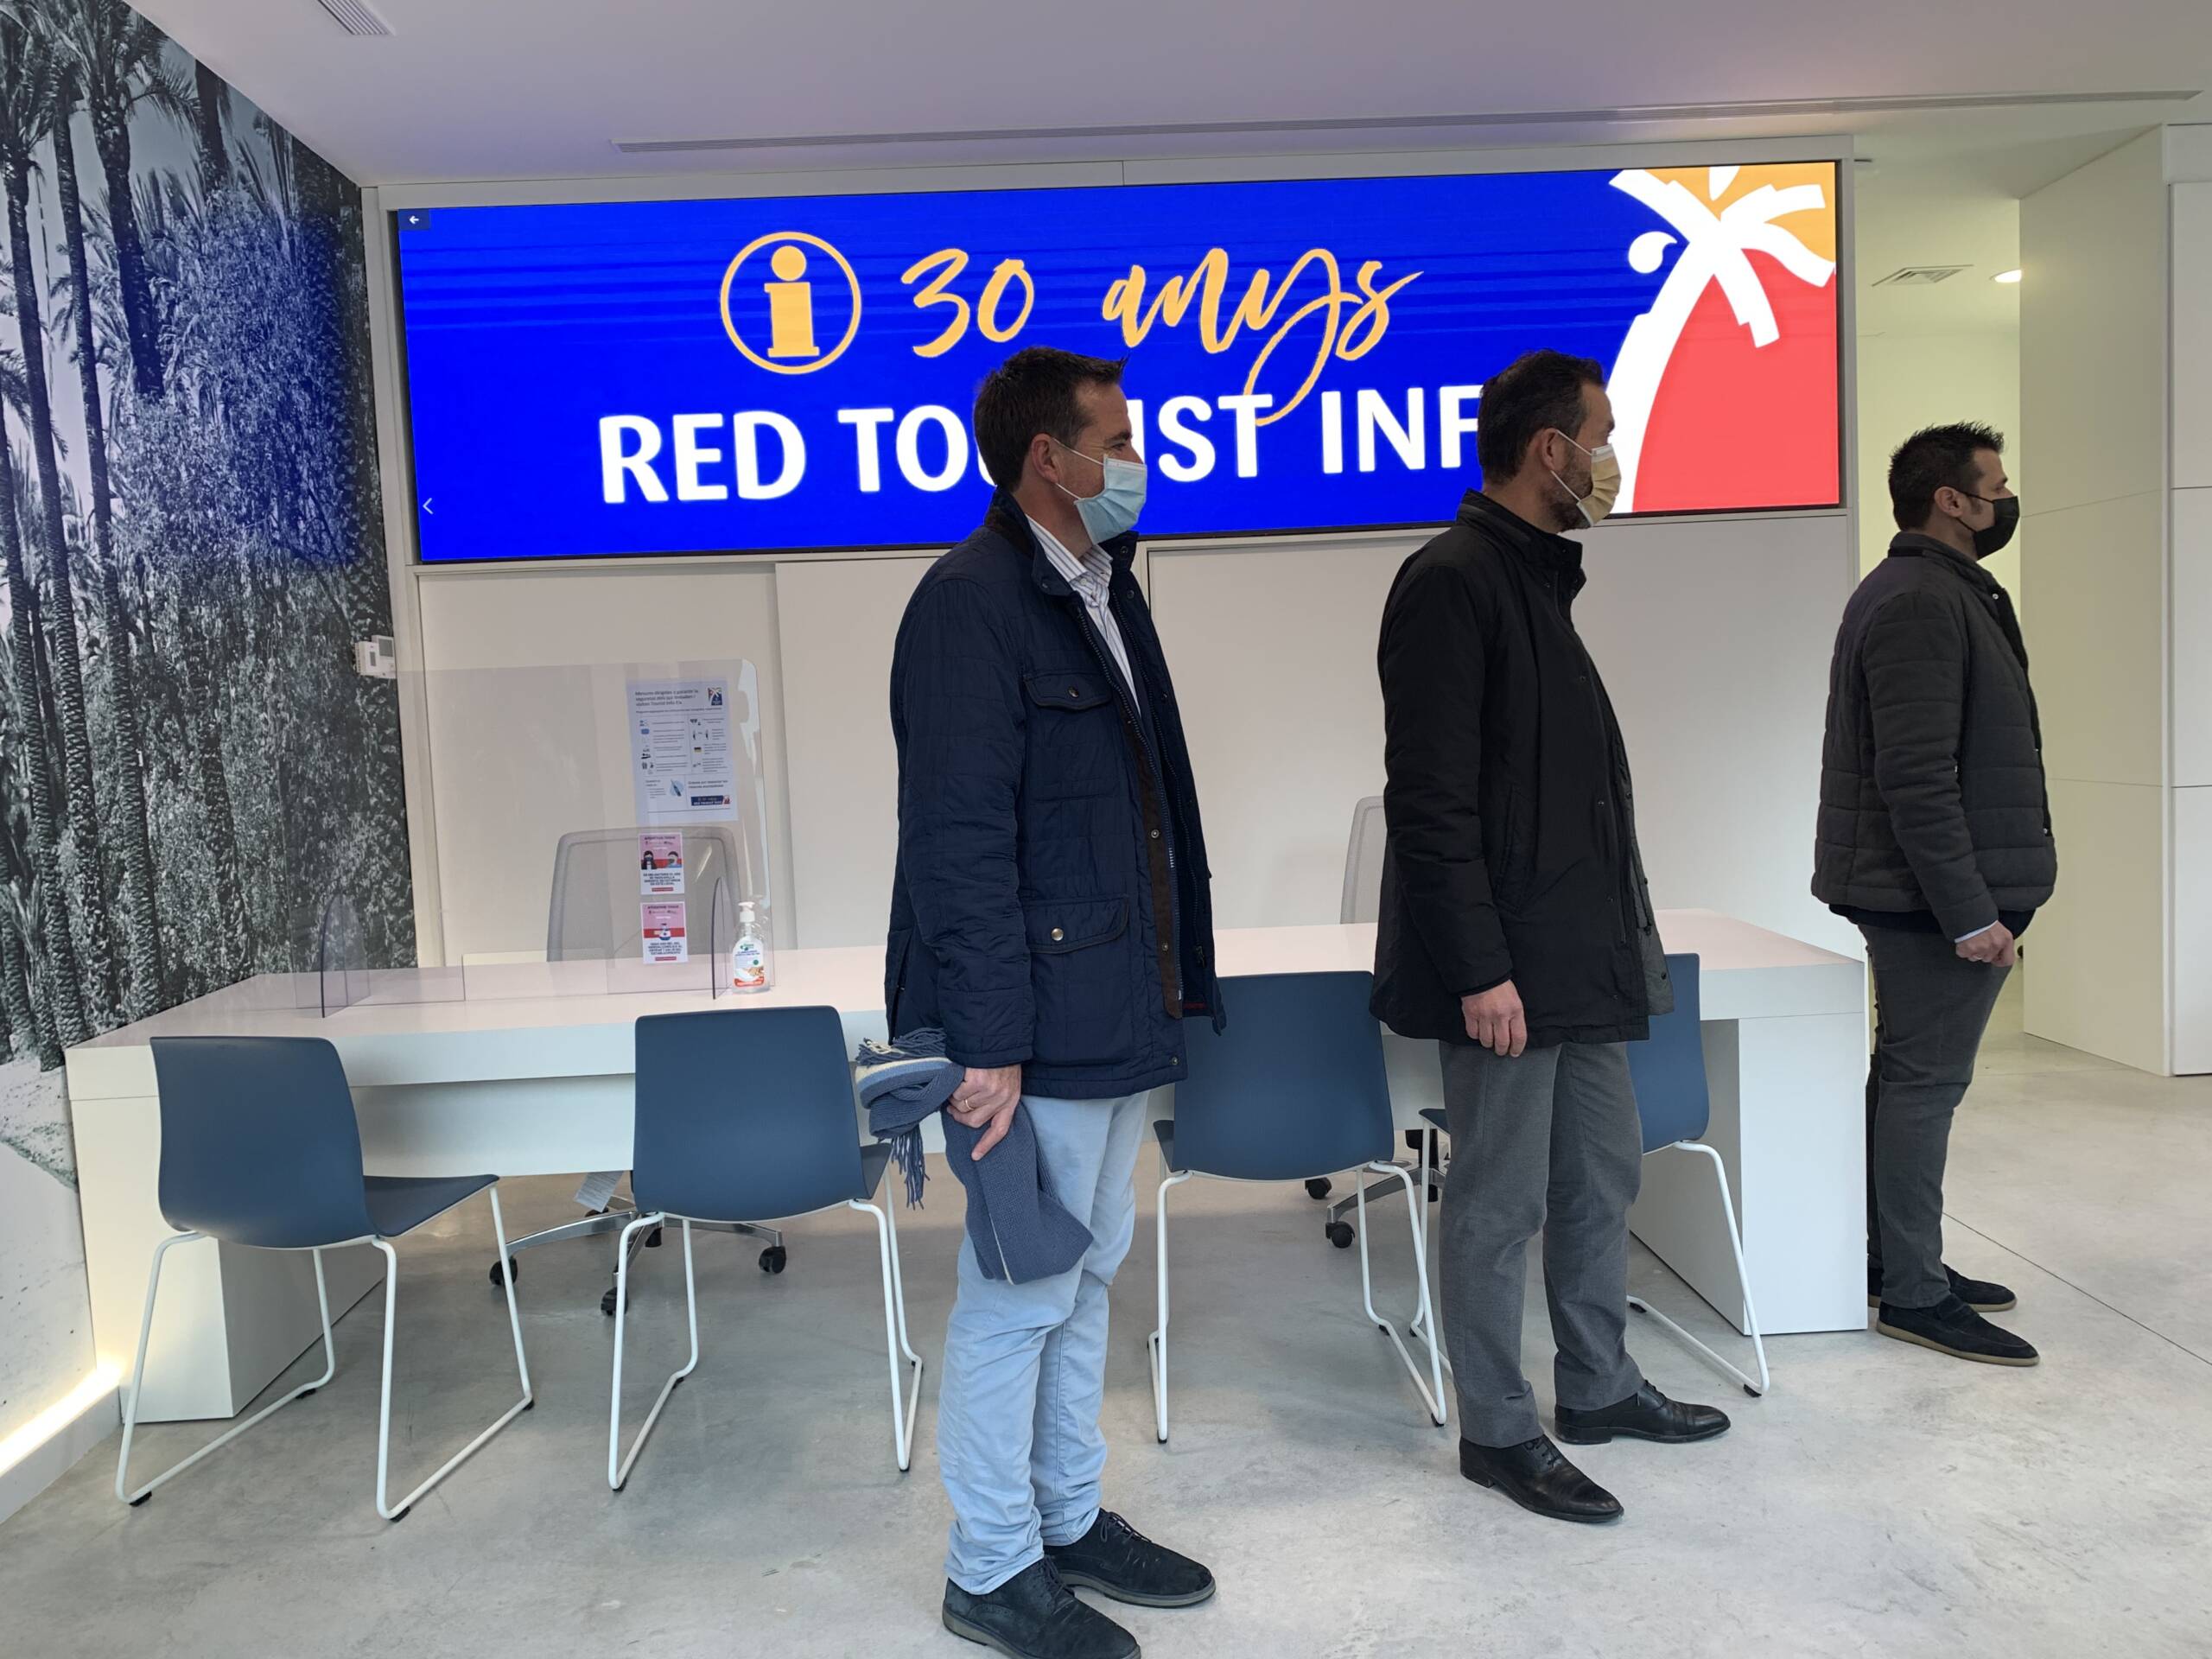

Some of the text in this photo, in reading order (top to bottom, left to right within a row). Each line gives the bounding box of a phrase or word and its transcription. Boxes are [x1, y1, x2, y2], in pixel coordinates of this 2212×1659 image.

[901, 248, 1035, 358] 30
[1103, 247, 1424, 427] anys
[599, 385, 1484, 504] RED TOIST INF
